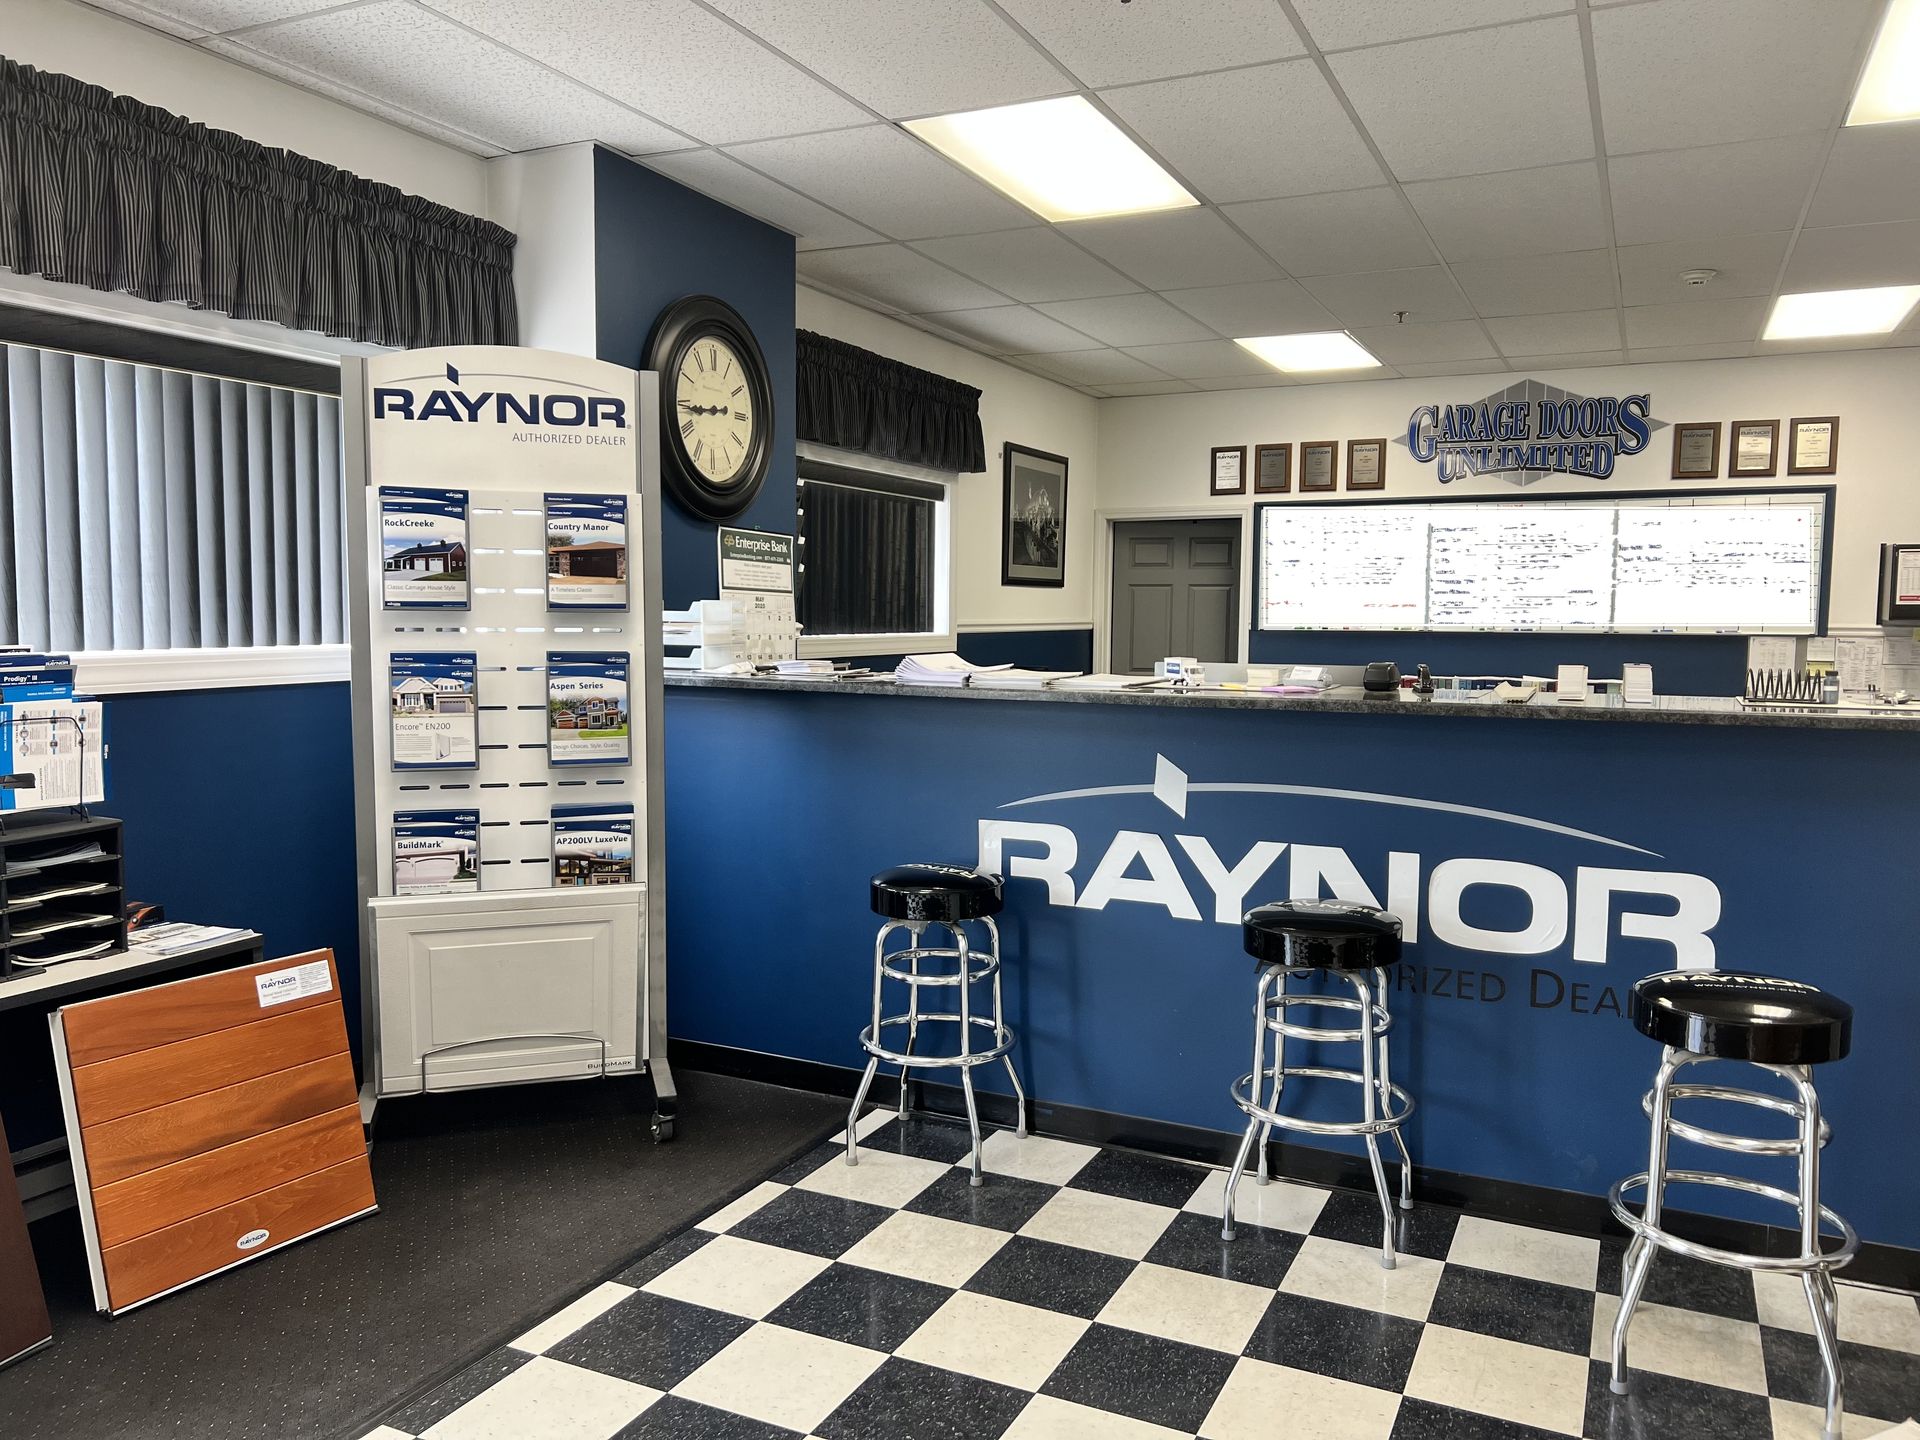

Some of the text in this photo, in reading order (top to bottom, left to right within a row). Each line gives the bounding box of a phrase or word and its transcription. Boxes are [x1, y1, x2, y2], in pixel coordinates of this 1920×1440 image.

[374, 388, 626, 428] RAYNOR
[1407, 394, 1651, 463] GARAGE DOORS
[512, 433, 626, 446] AUTHORIZED DEALER
[1436, 440, 1616, 483] UNLIMITED
[384, 518, 434, 528] RockCreeke
[548, 522, 580, 532] Country
[736, 536, 788, 552] Enterprise Bank
[556, 836, 593, 844] AP200LV
[977, 819, 1723, 969] RAYNOR
[261, 976, 296, 990] RAYNOR
